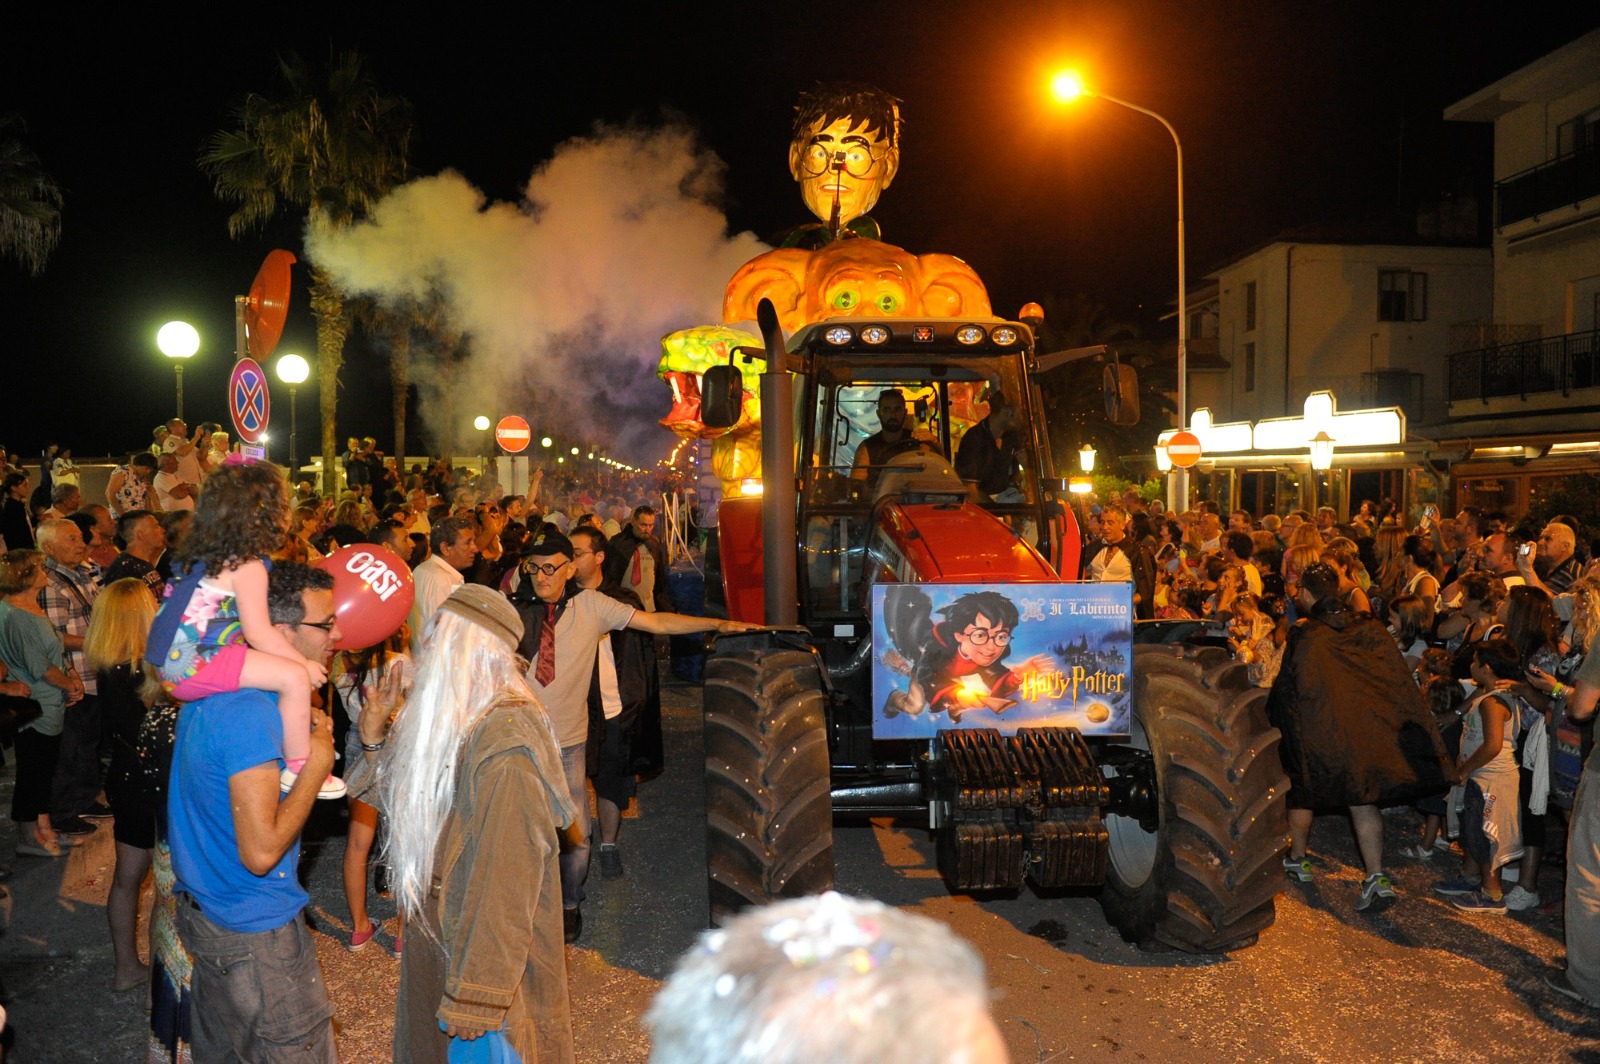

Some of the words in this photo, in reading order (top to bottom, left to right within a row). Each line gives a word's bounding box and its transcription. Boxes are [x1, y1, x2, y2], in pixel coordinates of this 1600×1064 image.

[1049, 602, 1062, 616] Il
[1069, 602, 1127, 615] Labirinto
[1020, 671, 1071, 702] Harry
[1072, 666, 1125, 712] Potter
